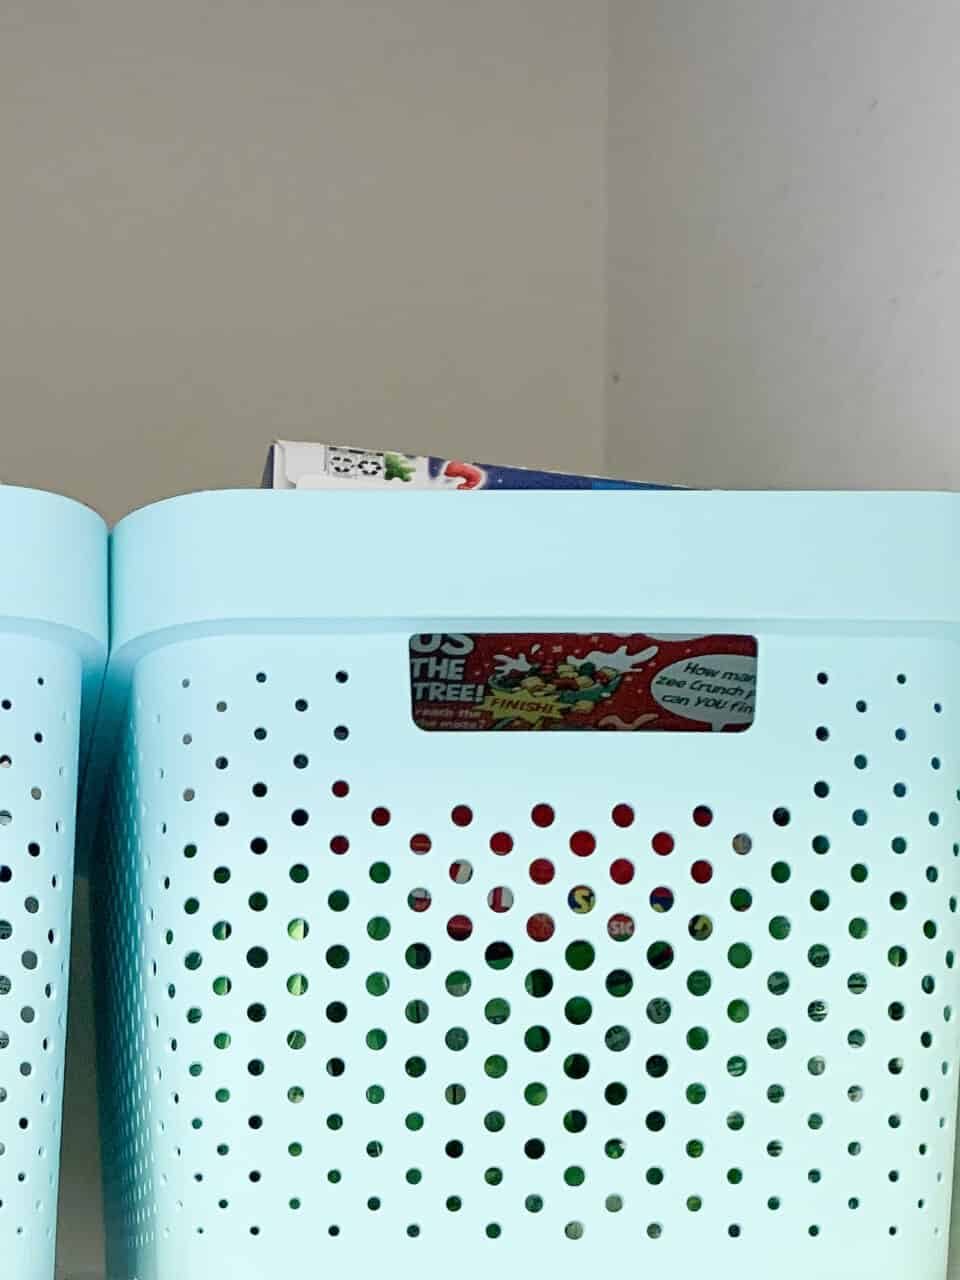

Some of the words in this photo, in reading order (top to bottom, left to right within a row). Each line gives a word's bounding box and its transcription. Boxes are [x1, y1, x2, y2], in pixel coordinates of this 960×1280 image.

[411, 656, 466, 681] THE
[684, 661, 720, 678] How
[722, 671, 756, 683] man
[413, 681, 486, 704] TREE!
[690, 680, 743, 697] Crunch
[490, 697, 557, 714] FINISH!
[662, 694, 691, 707] can
[730, 700, 754, 714] fin
